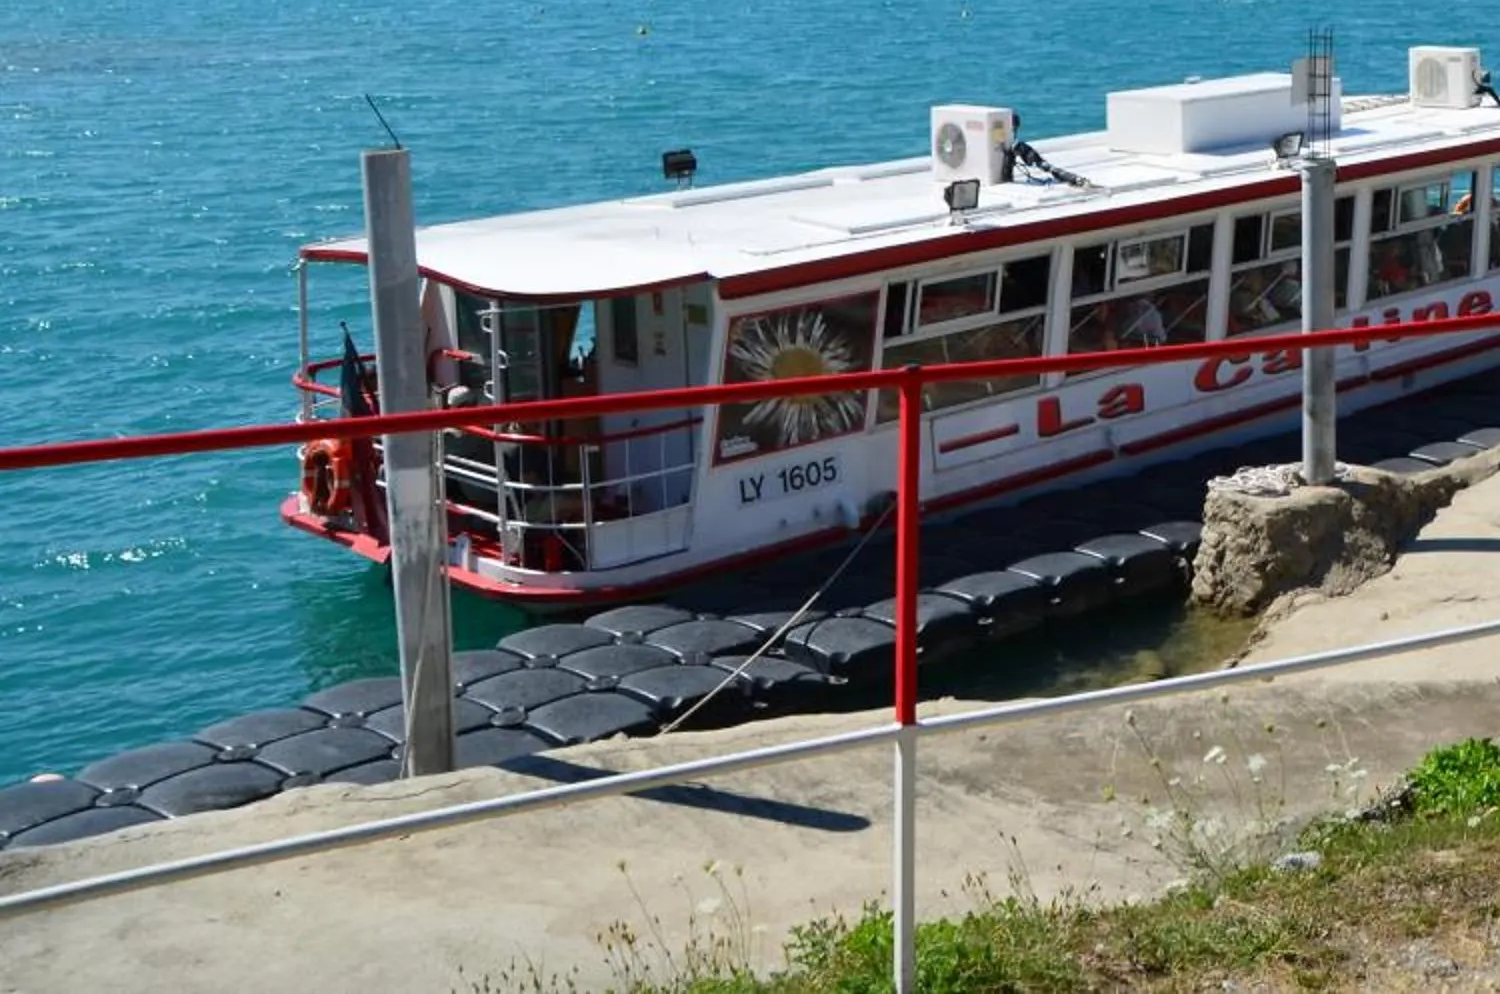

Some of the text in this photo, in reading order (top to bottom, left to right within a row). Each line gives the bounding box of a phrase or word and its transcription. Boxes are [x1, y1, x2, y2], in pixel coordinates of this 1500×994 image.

[1037, 289, 1494, 438] La Caline
[740, 456, 837, 503] LY 1605
